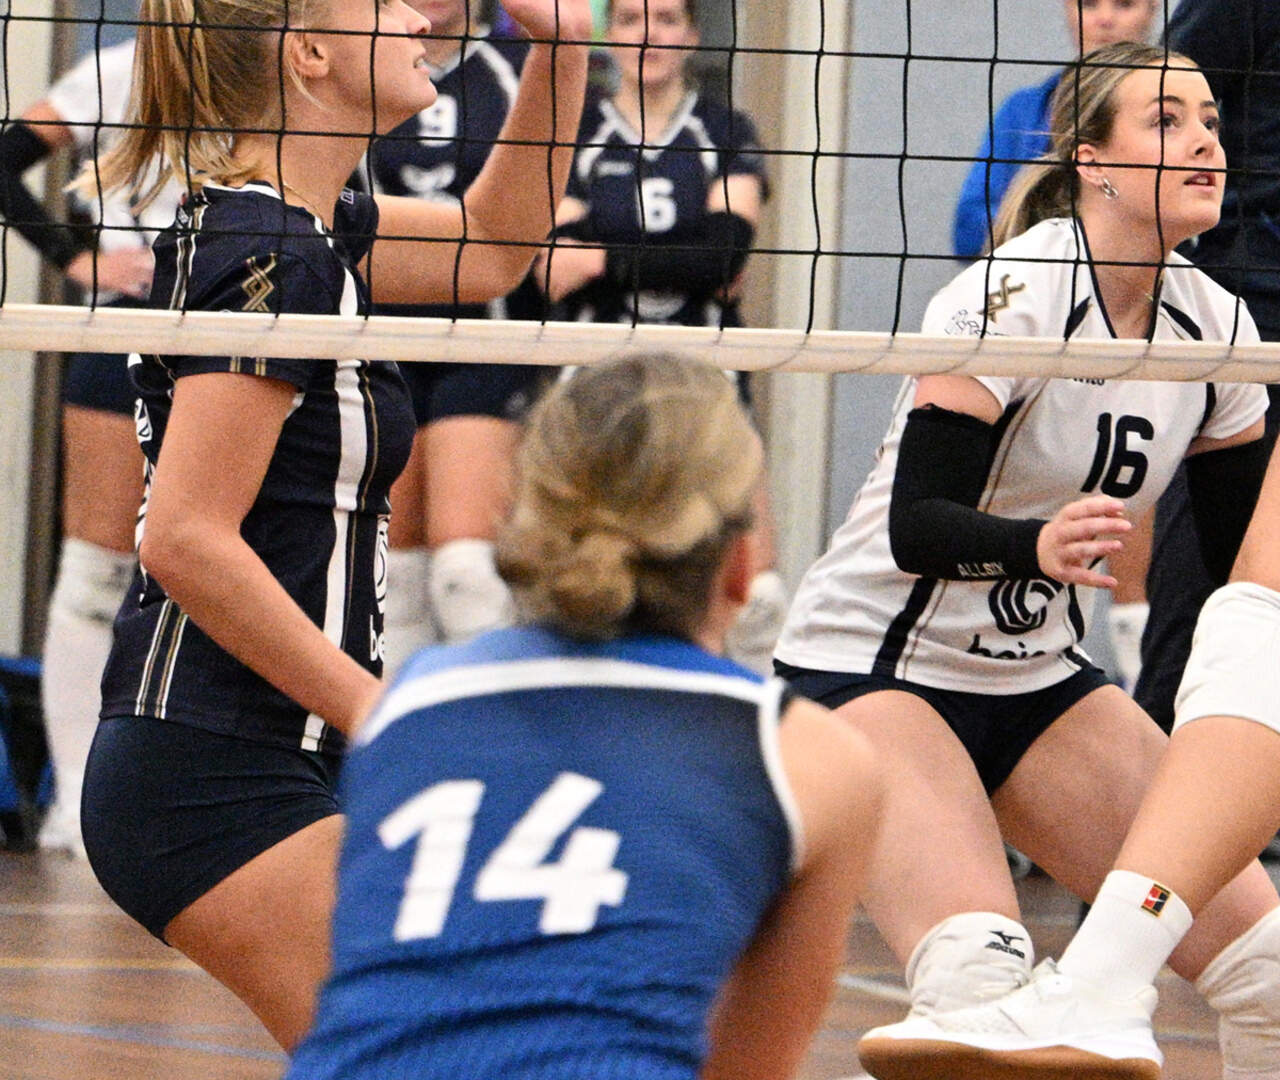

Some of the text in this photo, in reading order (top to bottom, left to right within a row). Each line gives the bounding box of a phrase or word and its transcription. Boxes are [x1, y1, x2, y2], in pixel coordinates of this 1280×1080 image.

[418, 93, 457, 147] 9
[637, 177, 677, 232] 6
[1080, 412, 1154, 498] 16
[377, 771, 629, 942] 14
